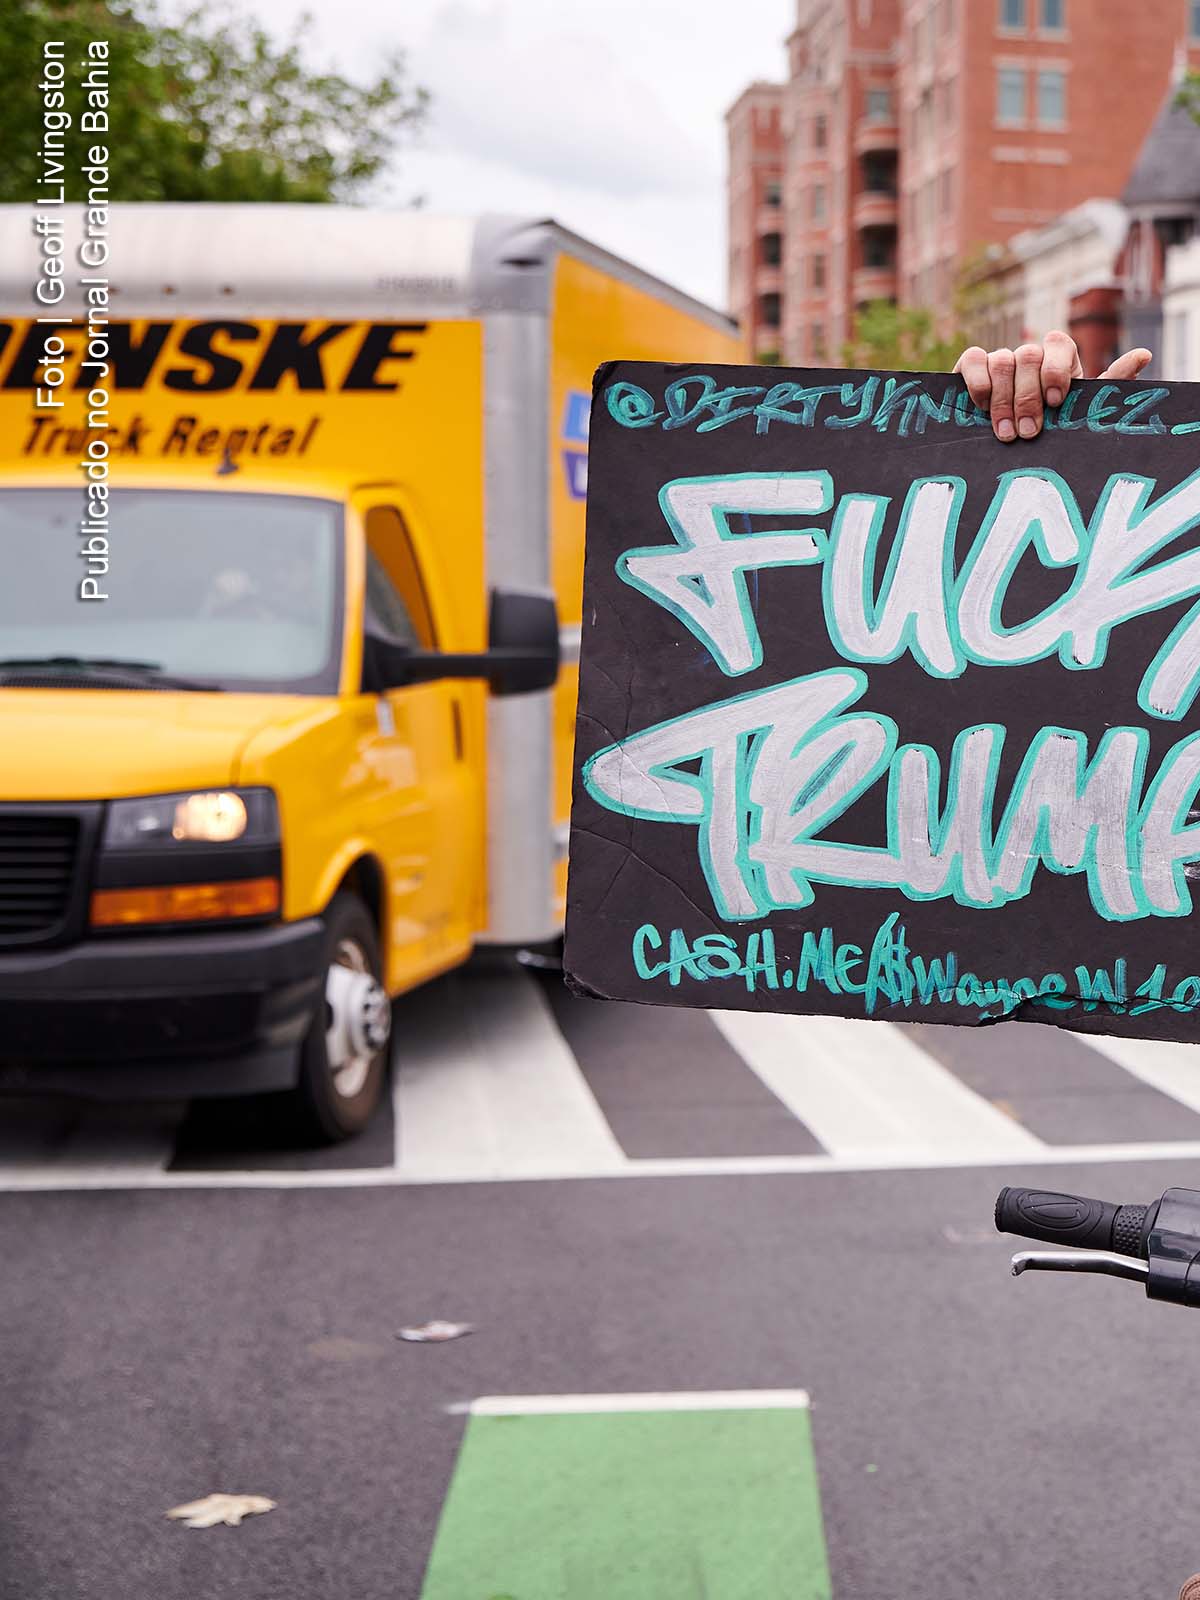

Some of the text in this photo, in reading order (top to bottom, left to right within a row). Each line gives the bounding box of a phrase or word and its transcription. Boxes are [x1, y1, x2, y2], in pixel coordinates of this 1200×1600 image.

[0, 321, 427, 393] ENSKE
[22, 415, 321, 457] Truck Rental
